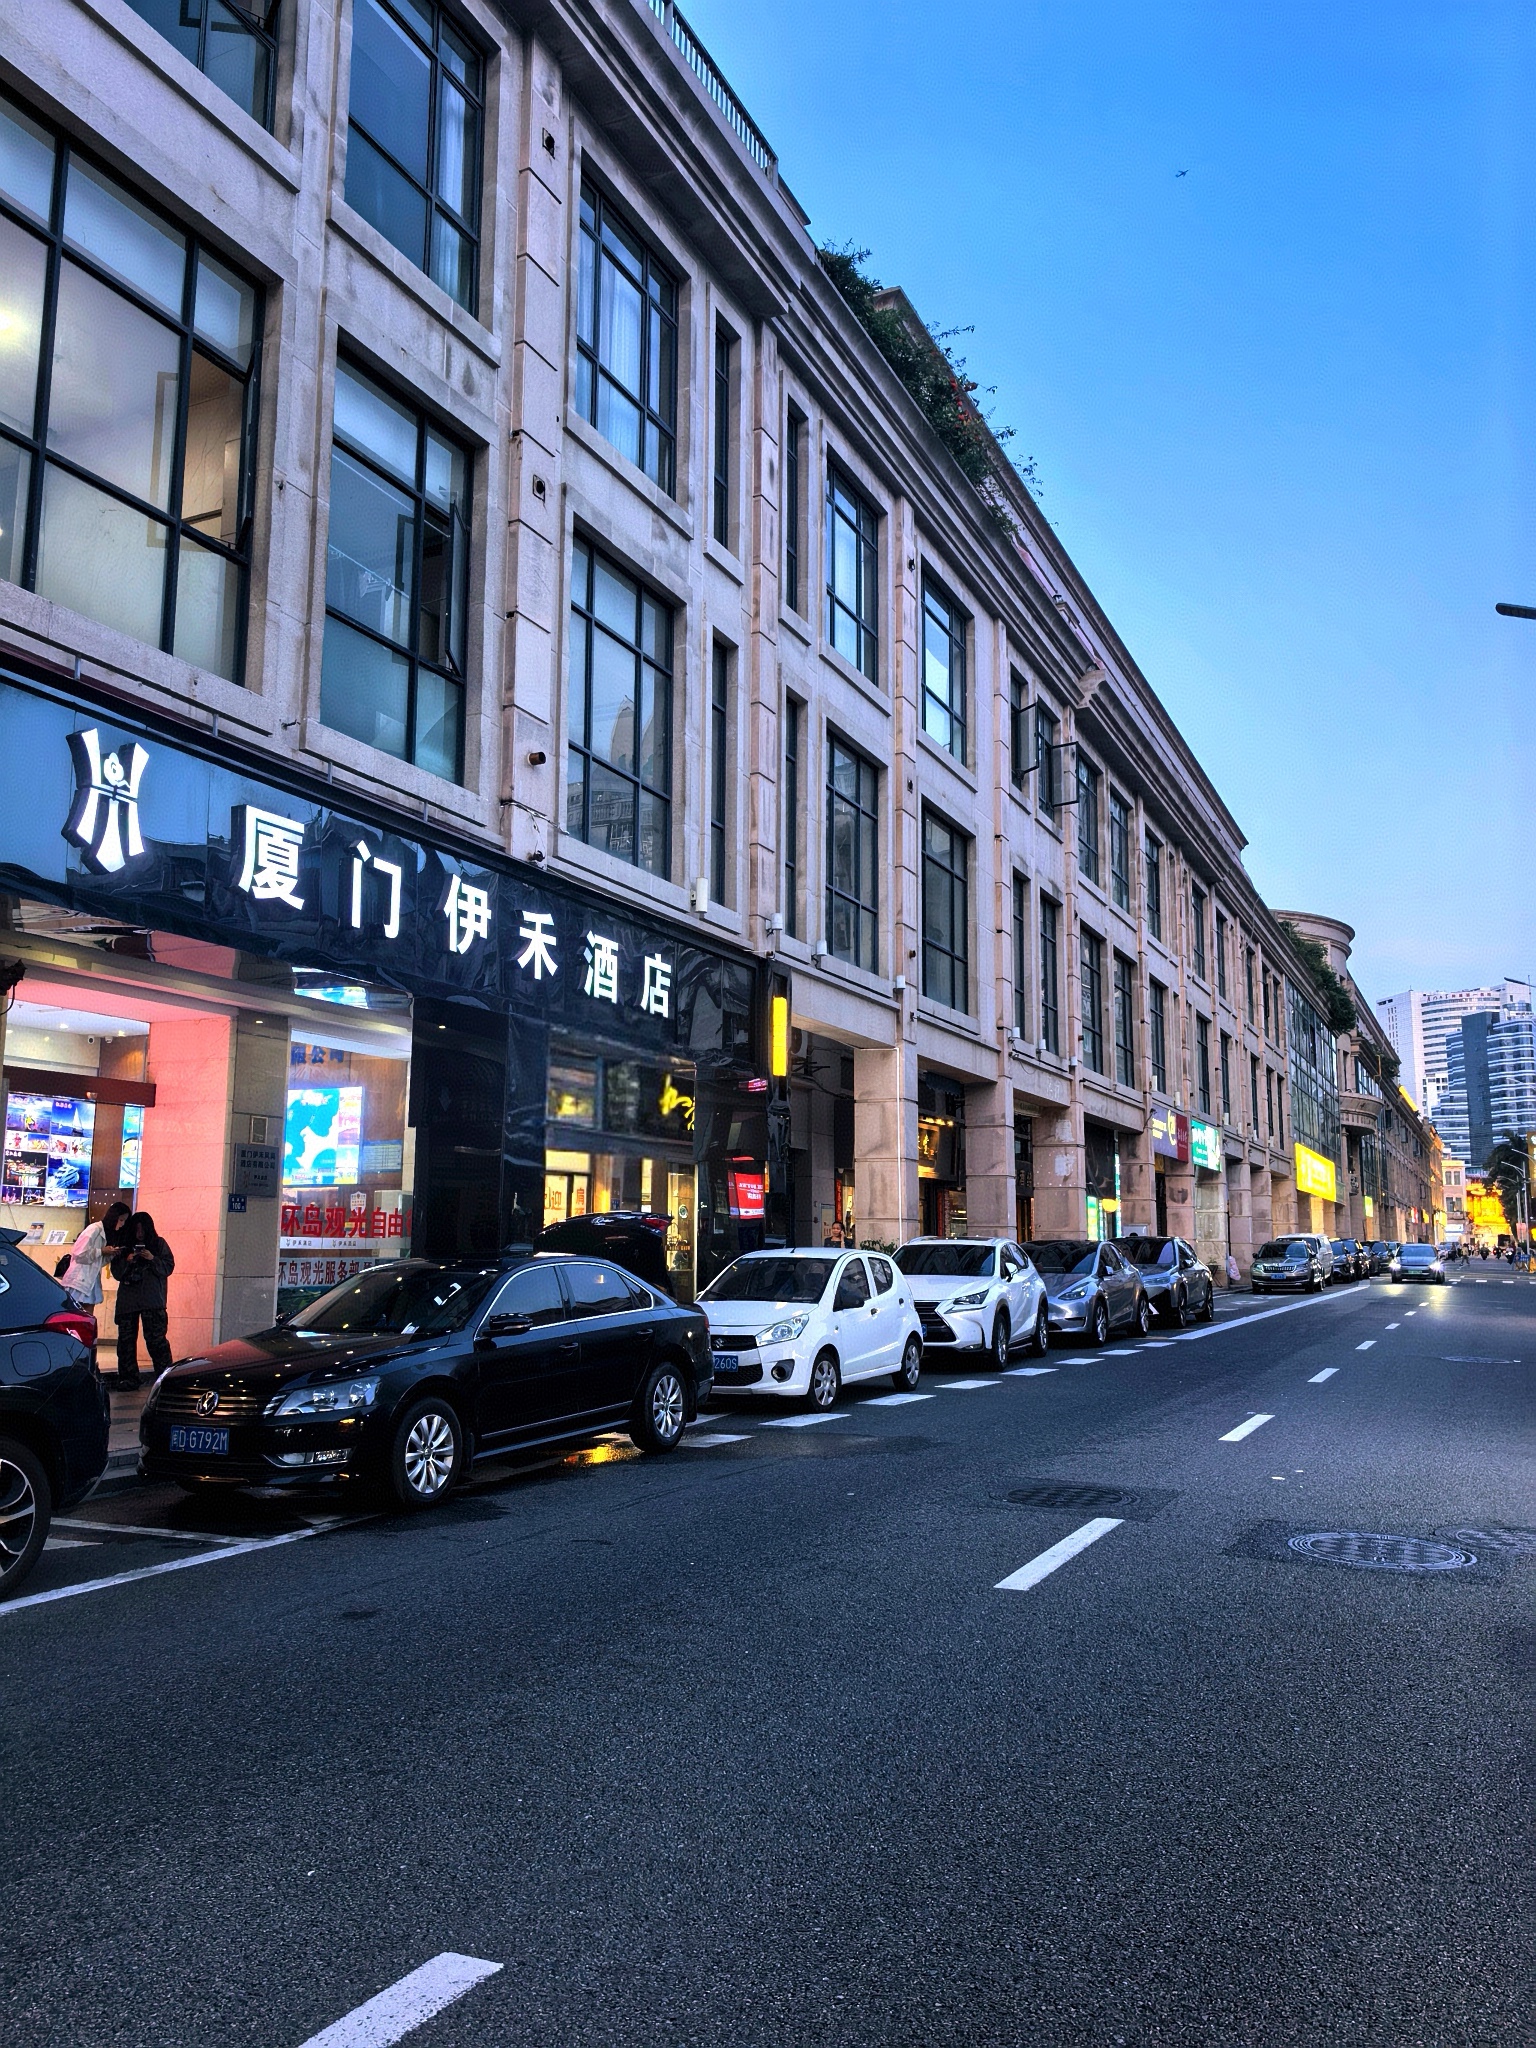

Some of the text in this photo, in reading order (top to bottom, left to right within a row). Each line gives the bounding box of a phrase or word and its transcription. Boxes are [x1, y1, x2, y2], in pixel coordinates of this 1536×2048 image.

[237, 804, 672, 1018] 厦门伊禾酒店
[714, 1357, 737, 1369] 260S
